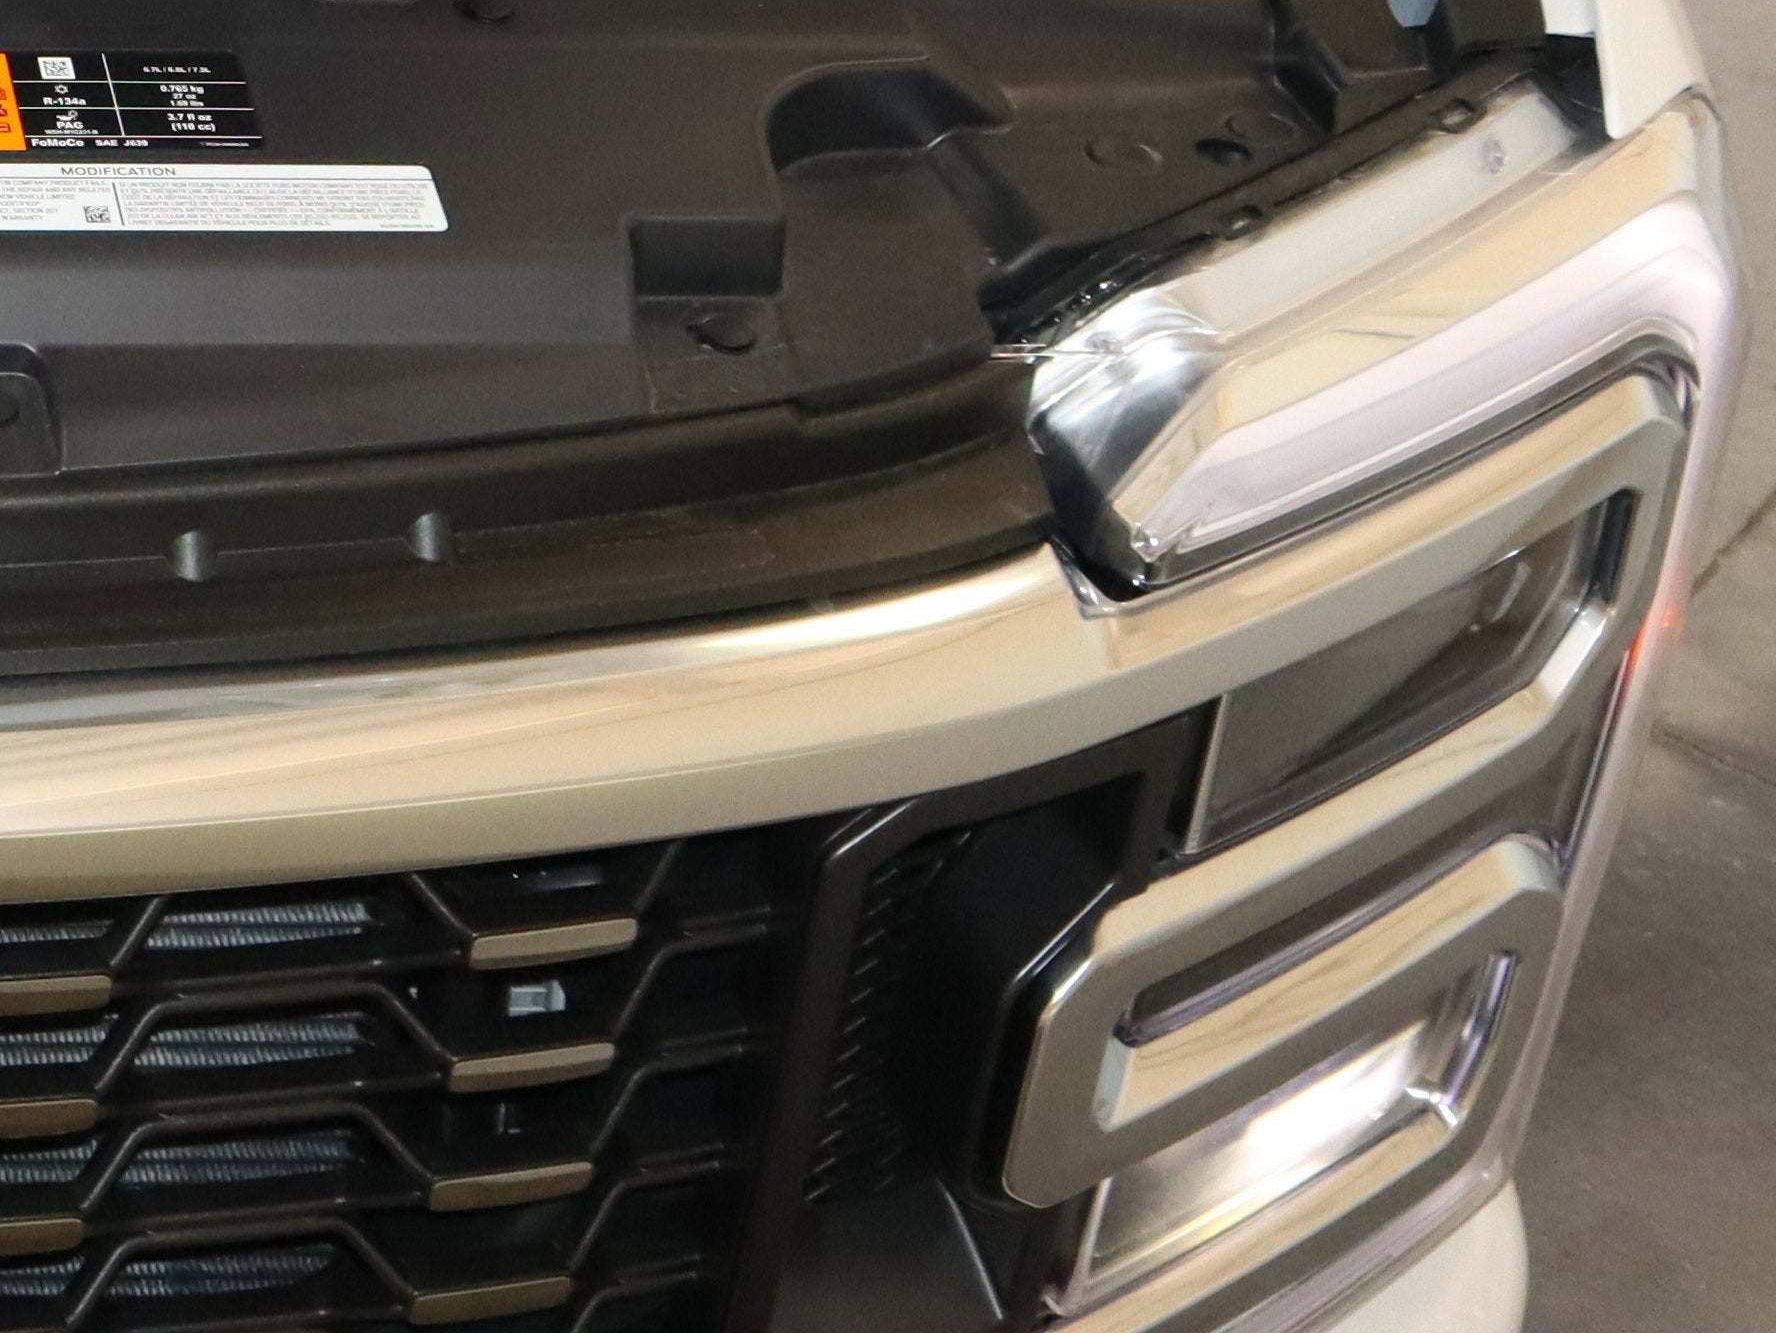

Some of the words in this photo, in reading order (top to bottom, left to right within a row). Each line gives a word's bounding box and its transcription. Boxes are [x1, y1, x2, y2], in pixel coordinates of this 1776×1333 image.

[160, 85, 186, 94] 0.765
[188, 85, 205, 95] kg
[43, 97, 87, 106] R-134a
[167, 113, 185, 121] 3.7
[188, 113, 196, 121] fl
[56, 121, 83, 130] PAG
[171, 122, 193, 132] (110
[197, 122, 216, 132] cc)
[31, 139, 84, 148] FoMoCo
[60, 167, 176, 176] MODIFICATION
